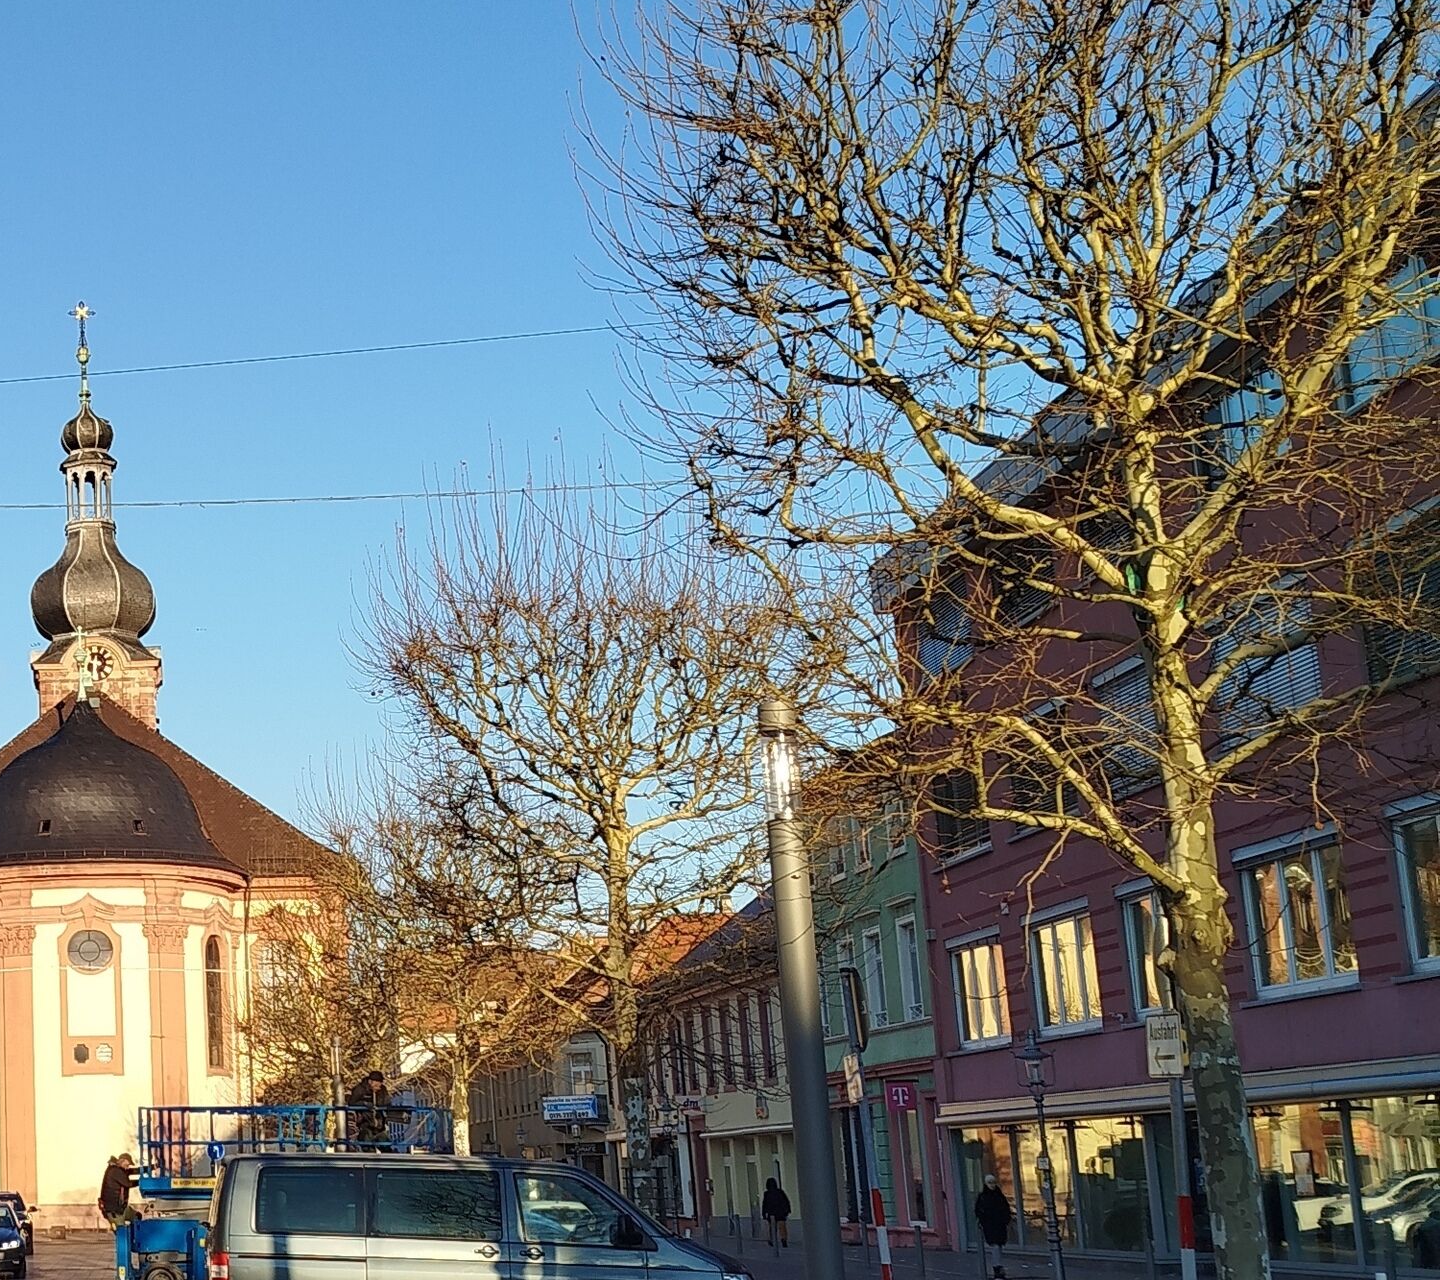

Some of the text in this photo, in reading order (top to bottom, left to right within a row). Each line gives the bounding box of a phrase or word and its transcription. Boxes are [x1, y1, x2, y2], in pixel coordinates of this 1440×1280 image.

[1149, 1022, 1178, 1040] Ausfahrt
[683, 1098, 699, 1107] dm
[892, 1086, 909, 1107] T
